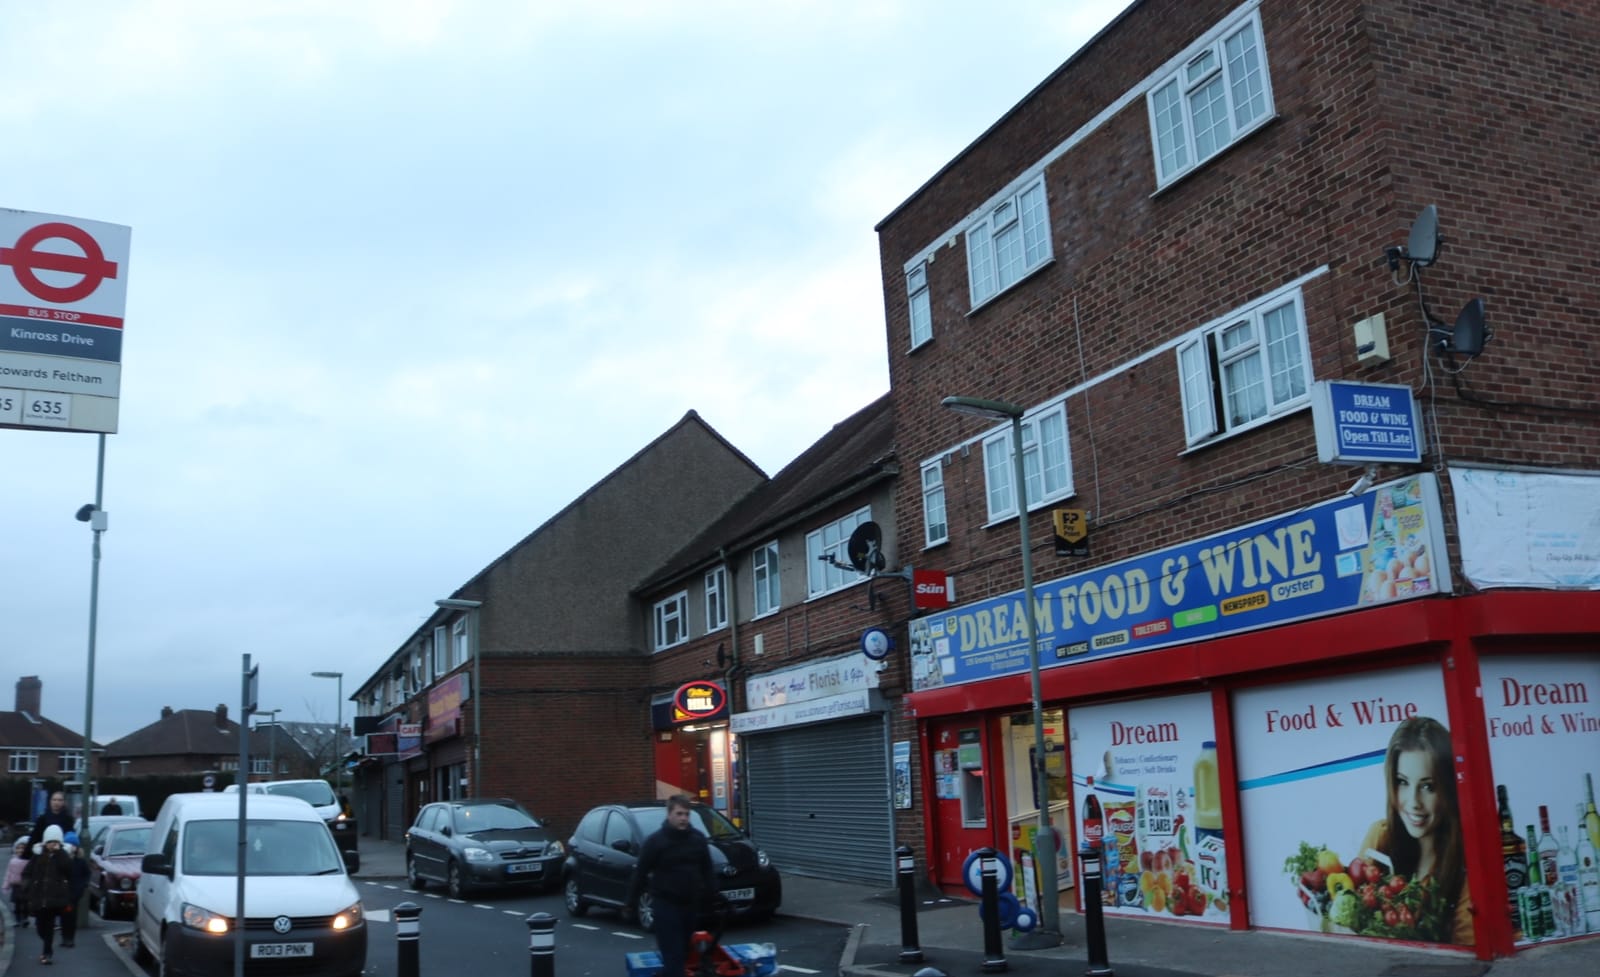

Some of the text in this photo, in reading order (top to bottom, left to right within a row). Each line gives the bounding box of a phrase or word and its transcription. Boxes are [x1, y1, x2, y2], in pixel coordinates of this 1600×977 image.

[28, 308, 81, 321] BUS STOP
[10, 327, 94, 346] Kinross Drive
[52, 370, 102, 384] Feltham
[32, 400, 62, 414] 635
[1353, 394, 1391, 408] DREAM
[1340, 410, 1408, 426] FOOD & WINE
[1343, 429, 1410, 444] Open Till Late
[960, 519, 1321, 652] DREAM FOOD & WINE
[1278, 577, 1314, 597] oyster
[1223, 594, 1266, 613] NEWSPAPER
[1095, 633, 1125, 647] GROCERIES
[808, 669, 841, 691] Florist
[1499, 677, 1588, 707] Dream
[1265, 697, 1418, 733] Food & Wine
[1110, 720, 1179, 746] Dream
[1490, 713, 1535, 738] Food
[1541, 714, 1555, 735] &
[1148, 799, 1170, 817] CORN
[1149, 817, 1171, 833] FLAKES
